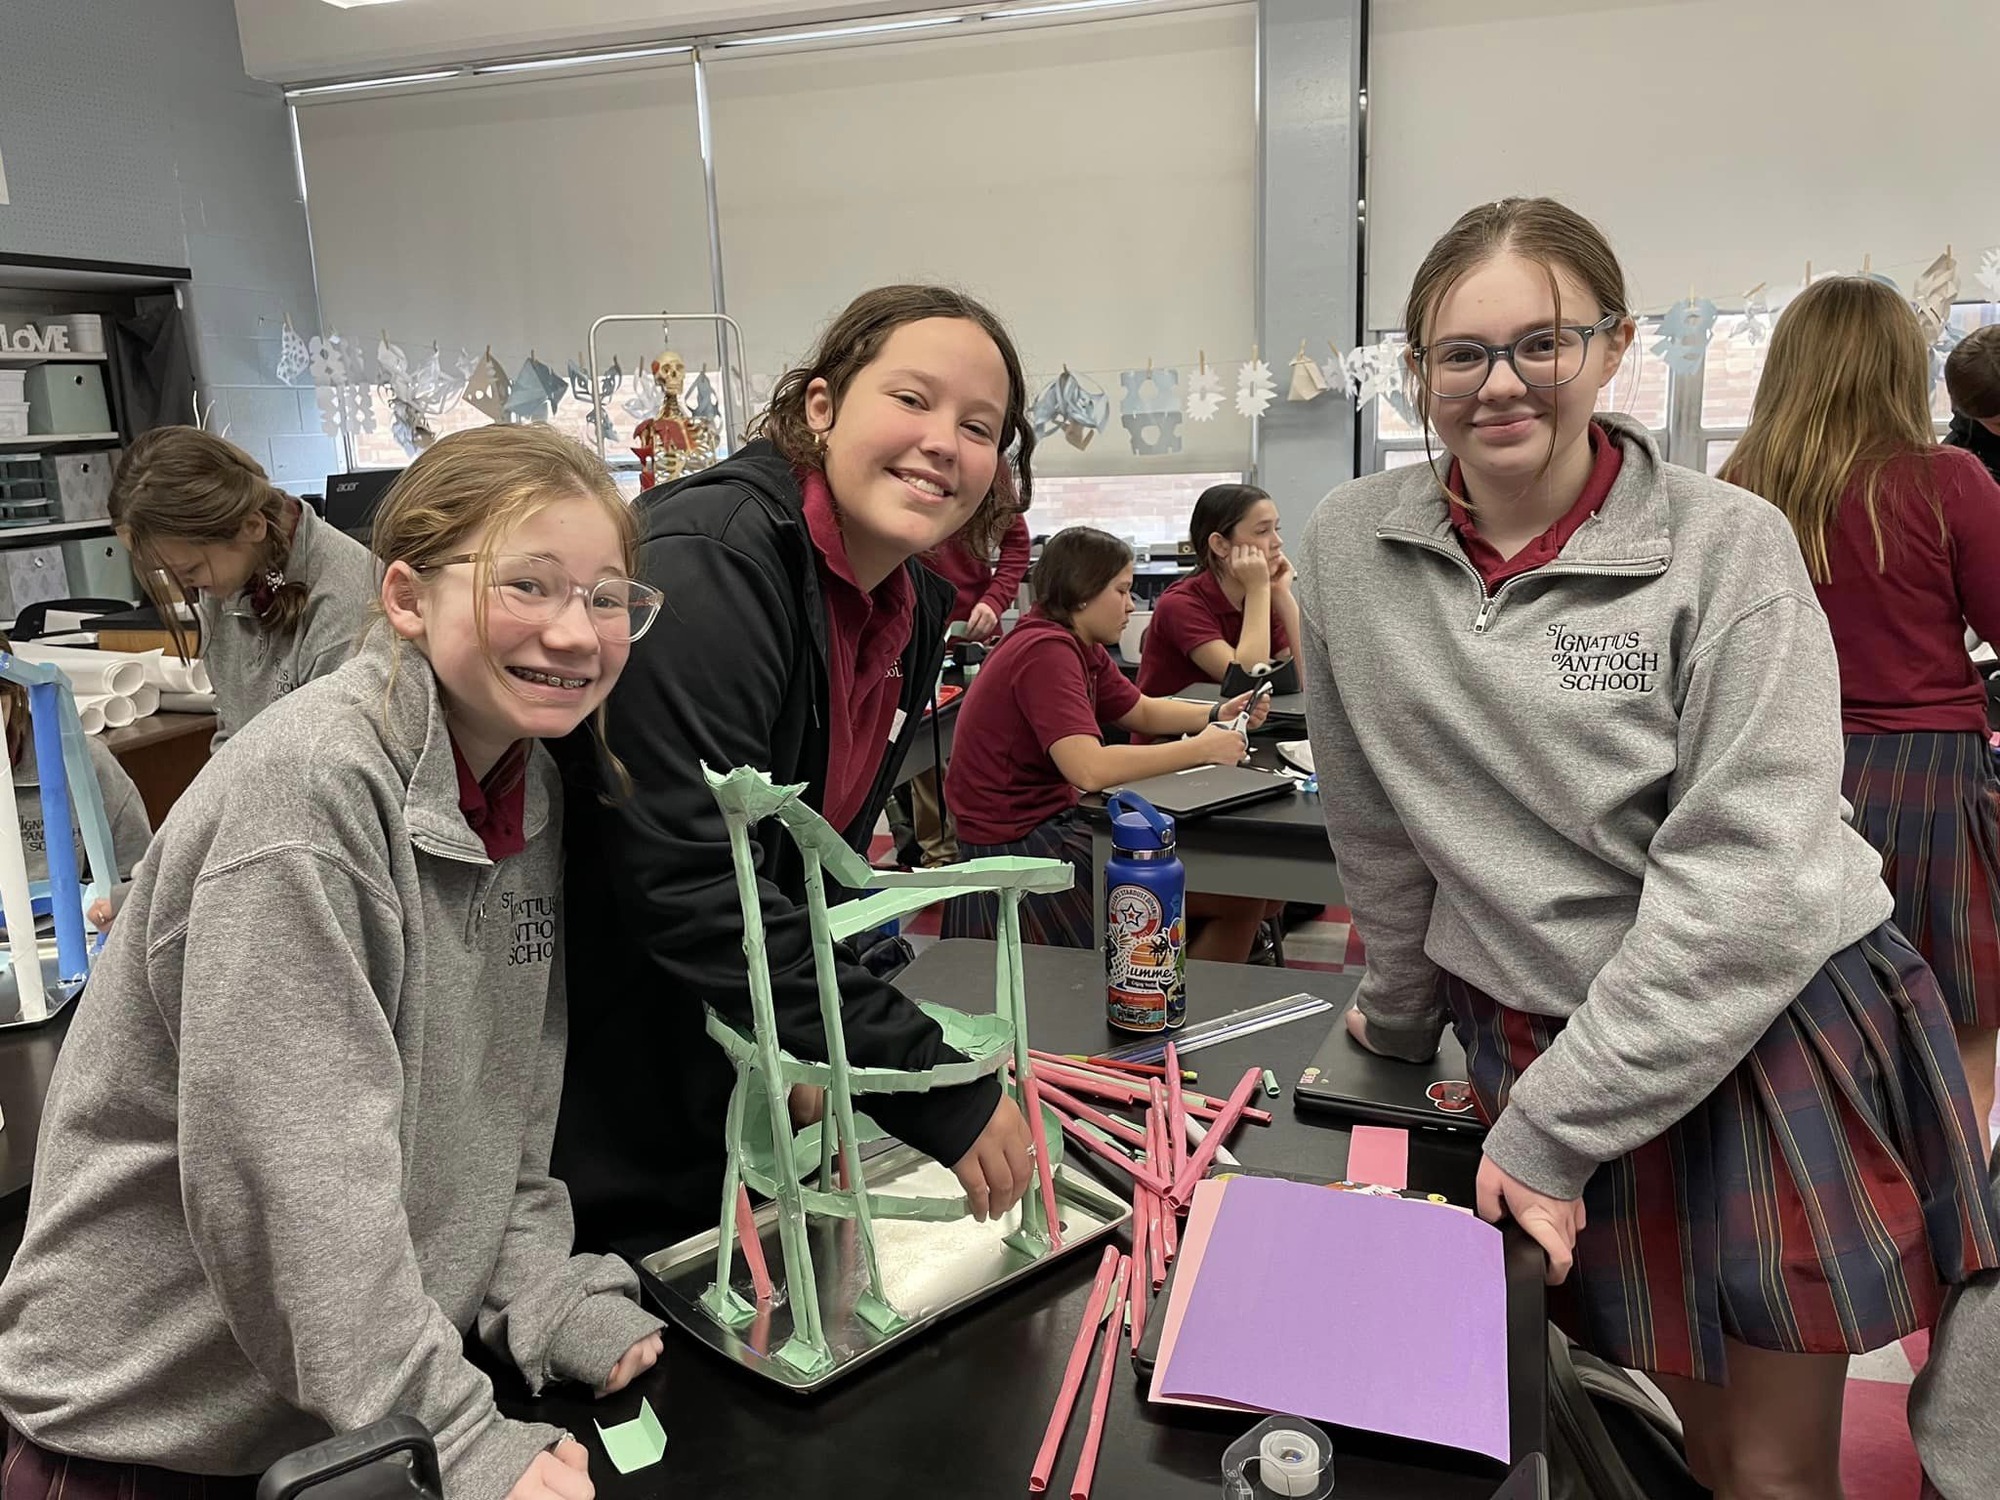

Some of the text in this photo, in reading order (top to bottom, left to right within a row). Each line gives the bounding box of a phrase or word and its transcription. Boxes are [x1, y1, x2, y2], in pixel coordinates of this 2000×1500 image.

[0, 324, 70, 352] LOVE
[336, 482, 359, 492] acer
[1555, 631, 1640, 652] IGNATIUS
[1558, 652, 1658, 672] ANTIOCH
[1560, 673, 1654, 692] SCHOOL
